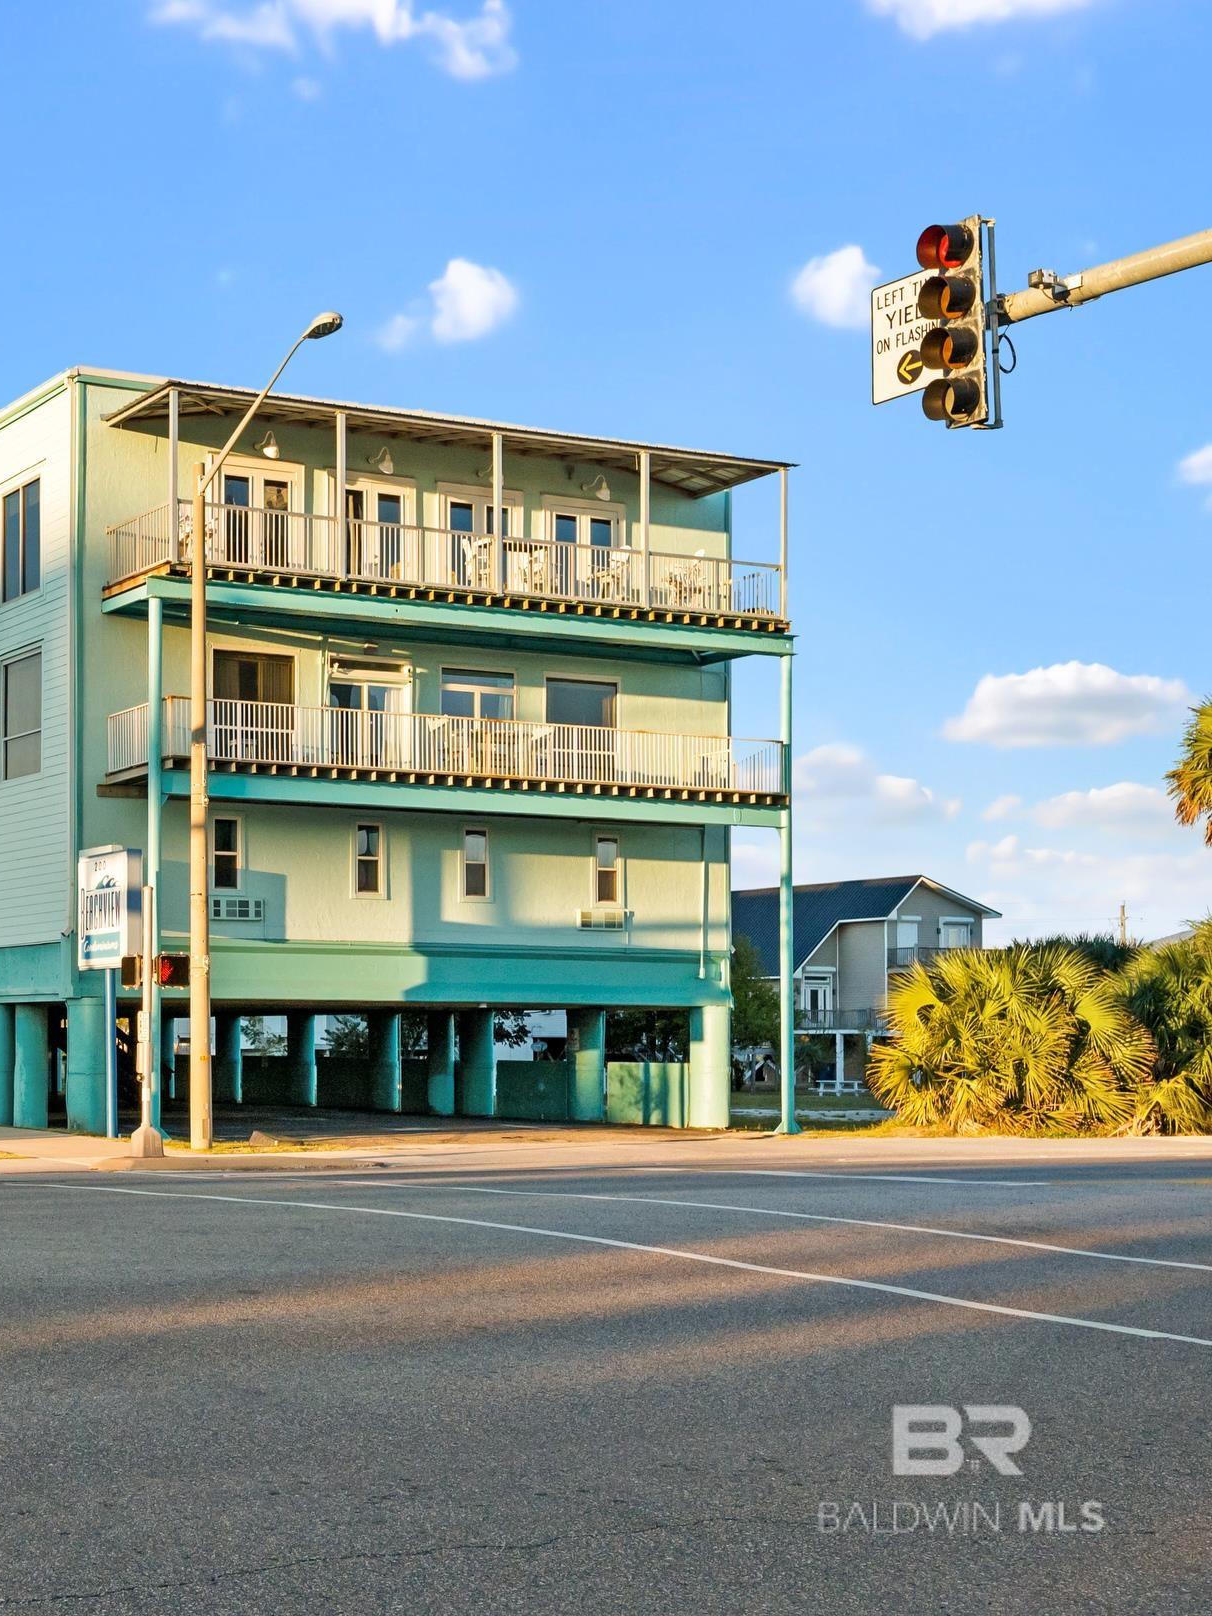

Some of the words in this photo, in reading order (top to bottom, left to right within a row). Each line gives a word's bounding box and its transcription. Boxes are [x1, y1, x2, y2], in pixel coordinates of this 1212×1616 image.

[877, 286, 905, 310] LEFT
[885, 302, 923, 330] YIEL
[876, 337, 890, 355] ON
[896, 320, 939, 348] FLASHIN
[81, 887, 121, 940] BEACHVIEW
